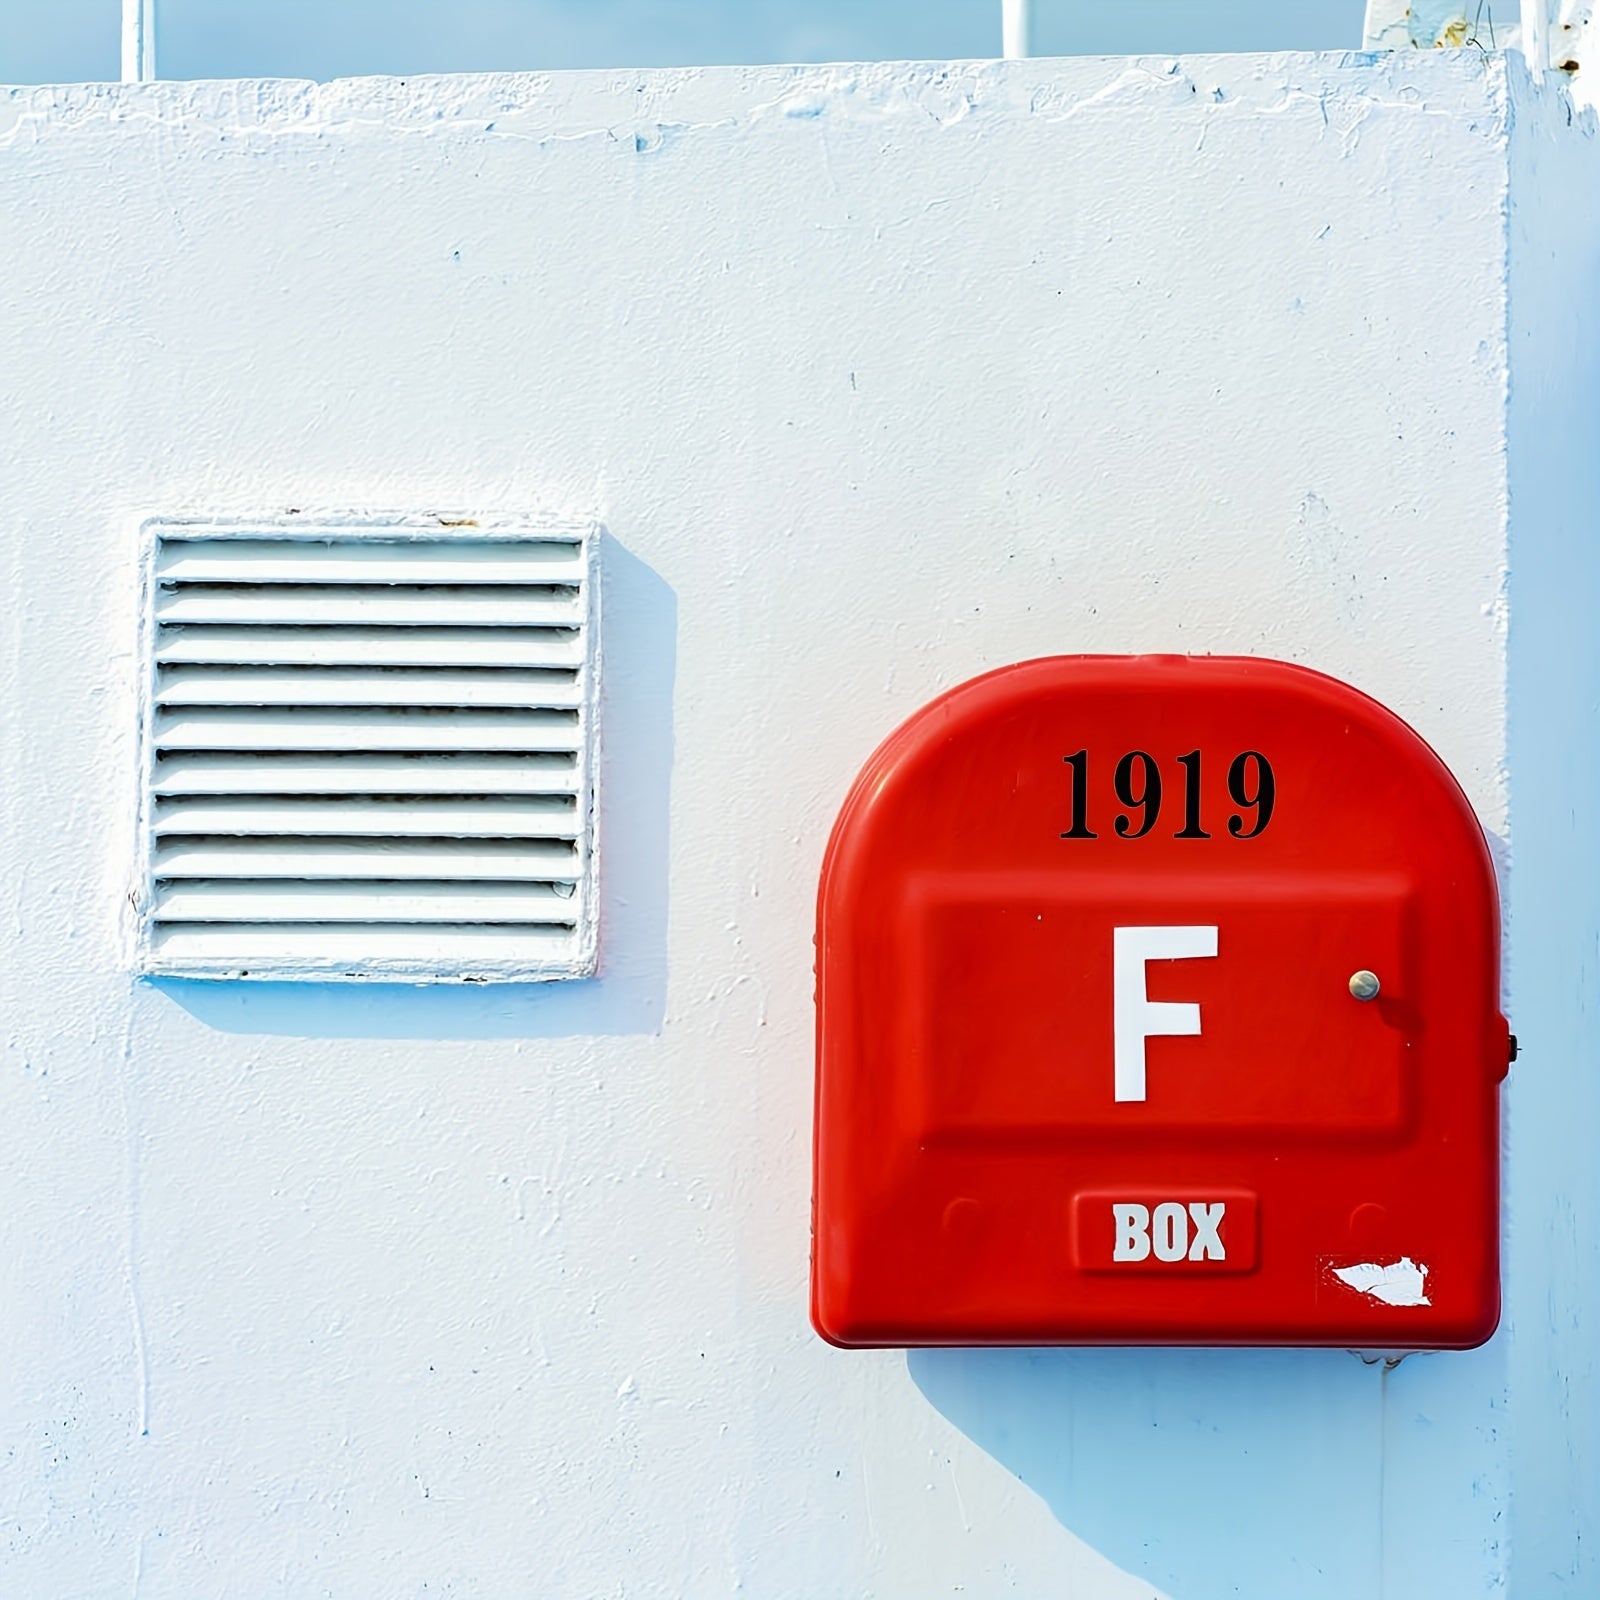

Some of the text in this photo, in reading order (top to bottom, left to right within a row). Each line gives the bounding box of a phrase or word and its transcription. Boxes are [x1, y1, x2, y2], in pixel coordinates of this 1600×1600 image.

[1060, 749, 1275, 839] 1919
[1113, 926, 1219, 1103] F
[1112, 1202, 1226, 1262] BOX
